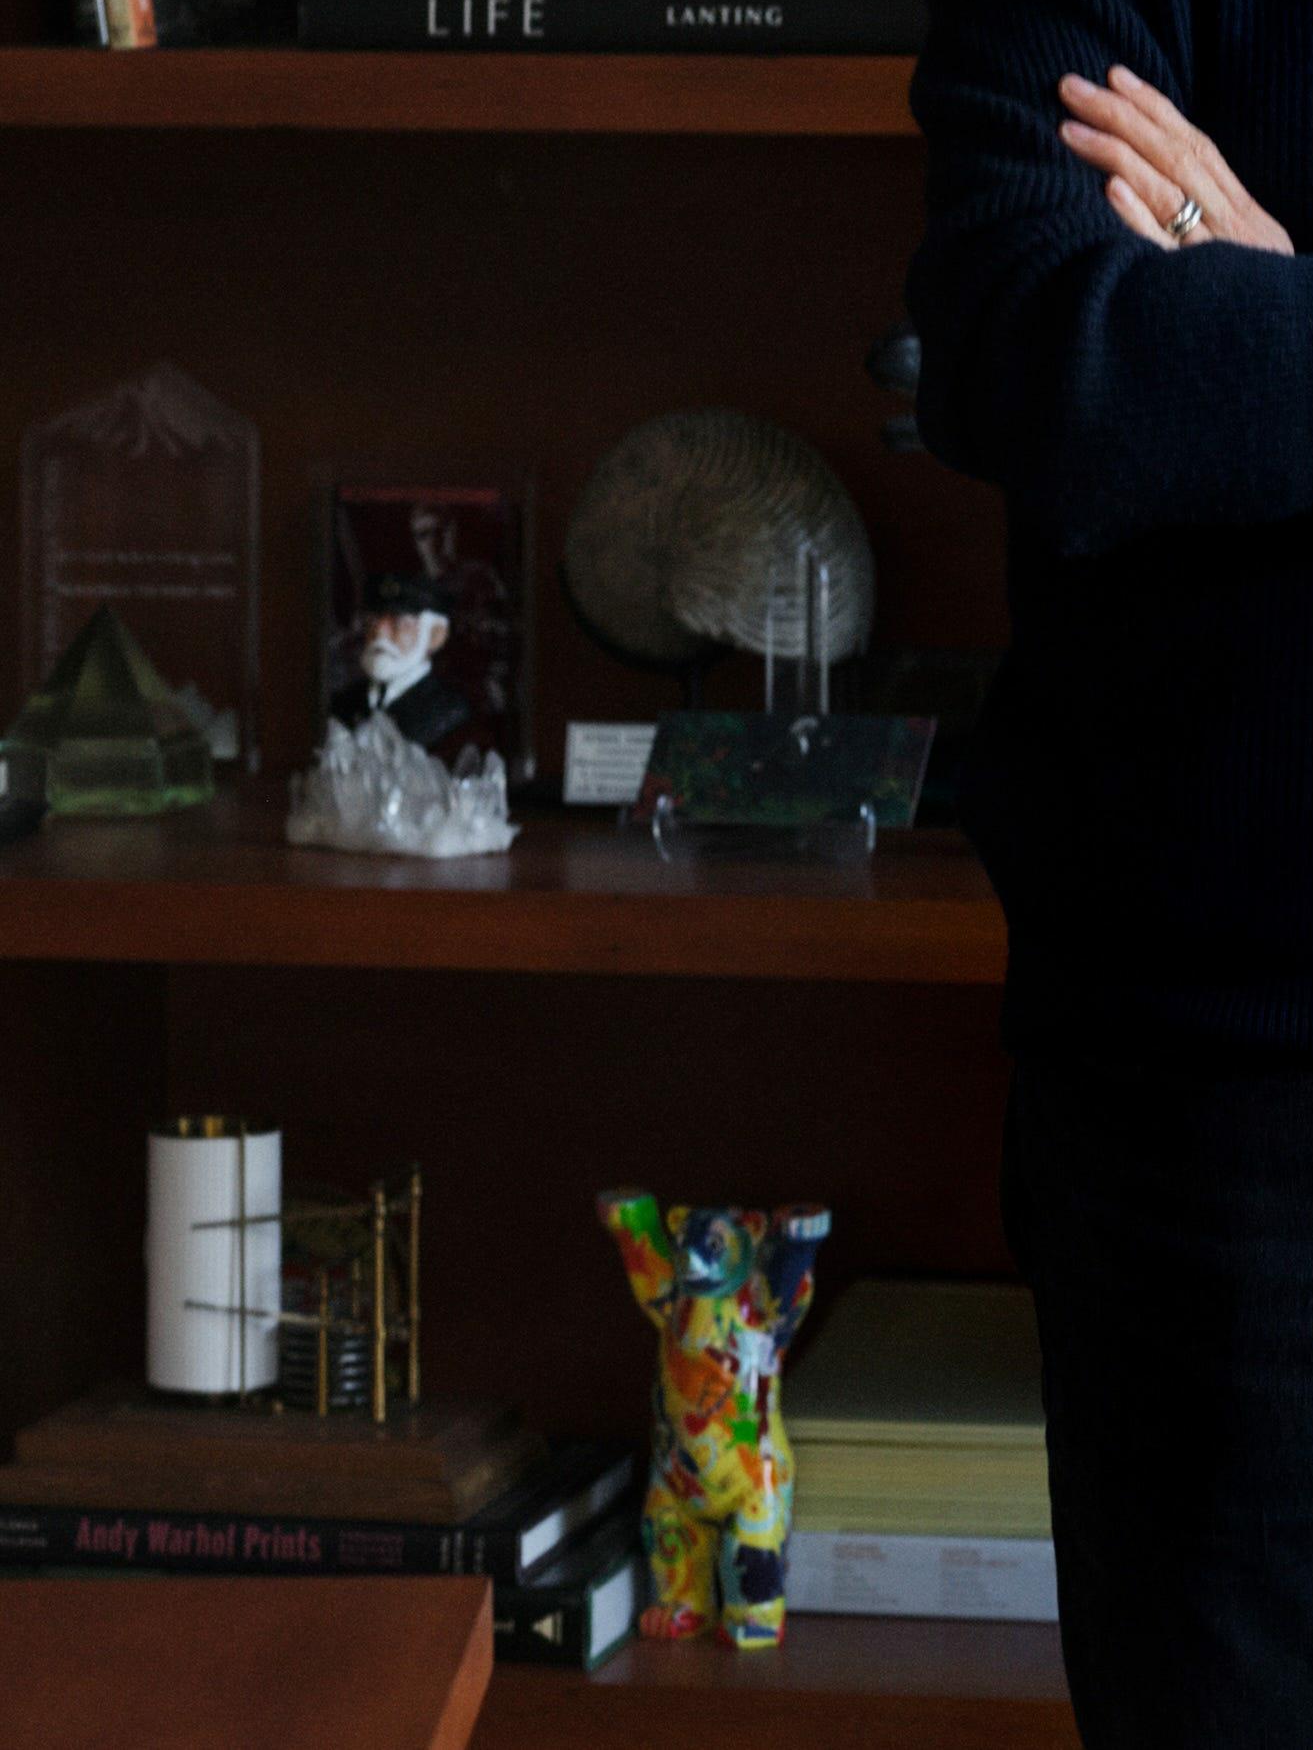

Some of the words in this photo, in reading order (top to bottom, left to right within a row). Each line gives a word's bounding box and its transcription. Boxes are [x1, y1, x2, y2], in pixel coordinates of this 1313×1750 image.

[664, 4, 784, 26] LANTING
[75, 1514, 139, 1561] Andy
[148, 1520, 237, 1559] Warhol
[244, 1522, 321, 1562] Prints
